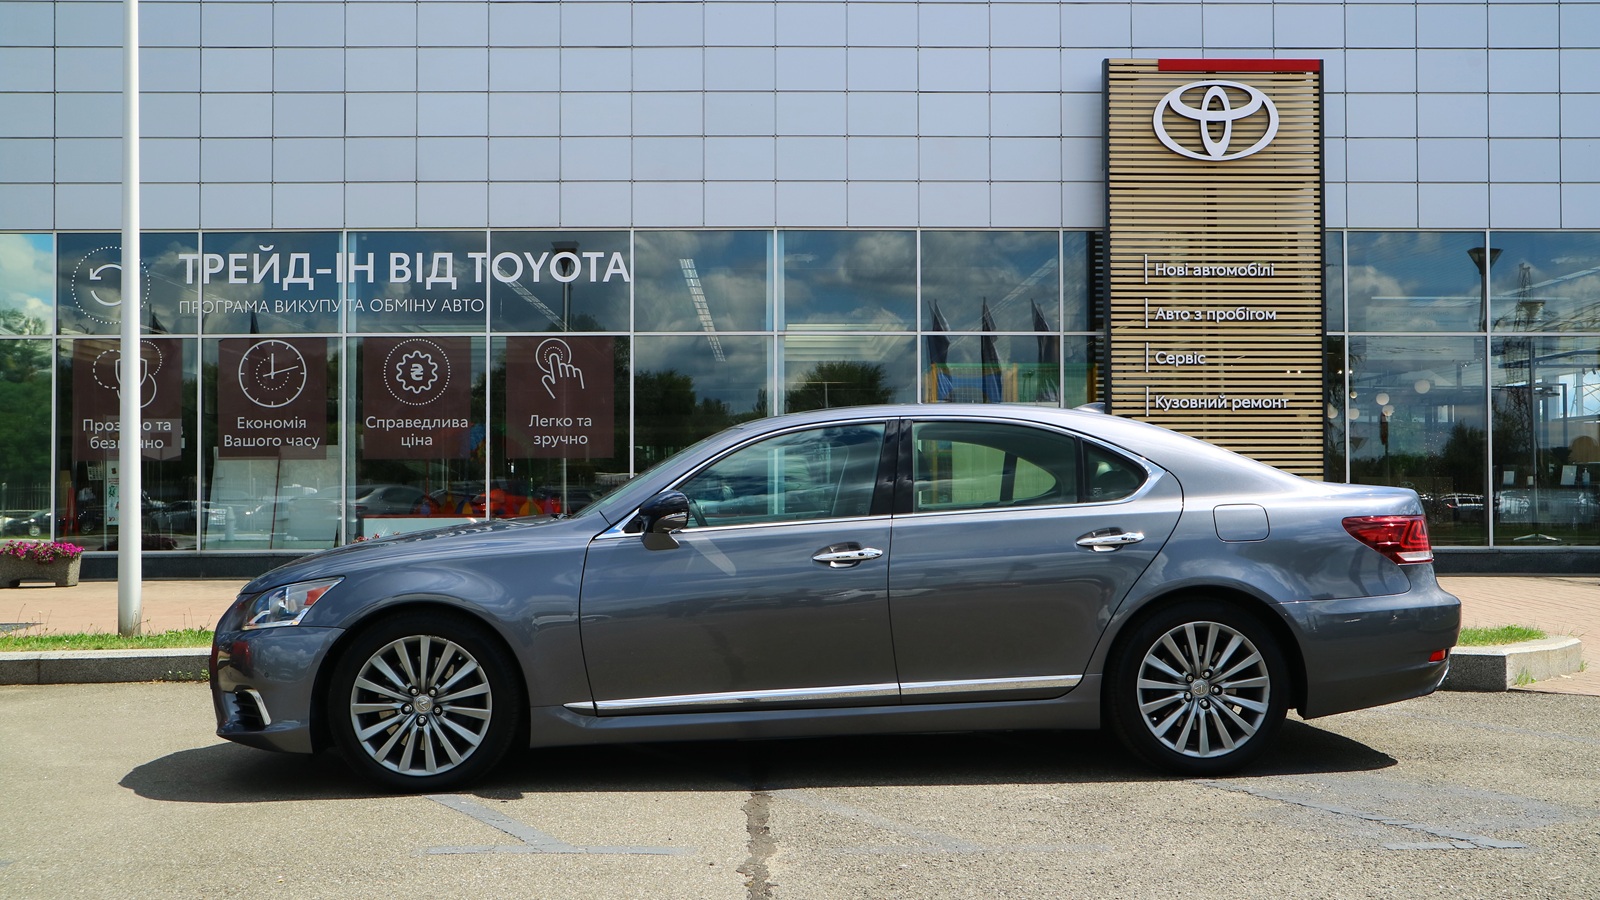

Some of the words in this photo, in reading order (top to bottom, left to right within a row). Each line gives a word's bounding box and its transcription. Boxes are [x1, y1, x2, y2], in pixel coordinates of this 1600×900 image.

[178, 244, 375, 291] ТРЕЙД-ІН
[389, 252, 458, 290] ВІД
[467, 251, 631, 284] TOYOTA
[1155, 263, 1188, 276] Нові
[1192, 263, 1275, 276] автомобілі
[179, 299, 270, 315] ПРОГРАМА
[275, 299, 340, 315] ВИКУПУ
[345, 299, 365, 314] ТА
[369, 298, 438, 314] ОБМІНУ
[441, 298, 485, 313] АВТО
[1155, 307, 1190, 320] Авто
[1194, 310, 1203, 320] з
[1206, 306, 1276, 323] пробігом
[1155, 351, 1206, 367] Сервіс
[1155, 395, 1227, 411] Кузовний
[1232, 398, 1288, 411] ремонт
[83, 418, 152, 434] Прозо
[156, 420, 172, 431] та
[236, 416, 307, 430] Економія
[365, 416, 469, 430] Справедлива
[528, 414, 573, 428] Легко
[576, 417, 592, 427] та
[90, 436, 164, 449] безно
[223, 435, 282, 448] Вашого
[286, 437, 320, 449] часу
[400, 434, 433, 448] ціна
[533, 432, 588, 446] зручно
